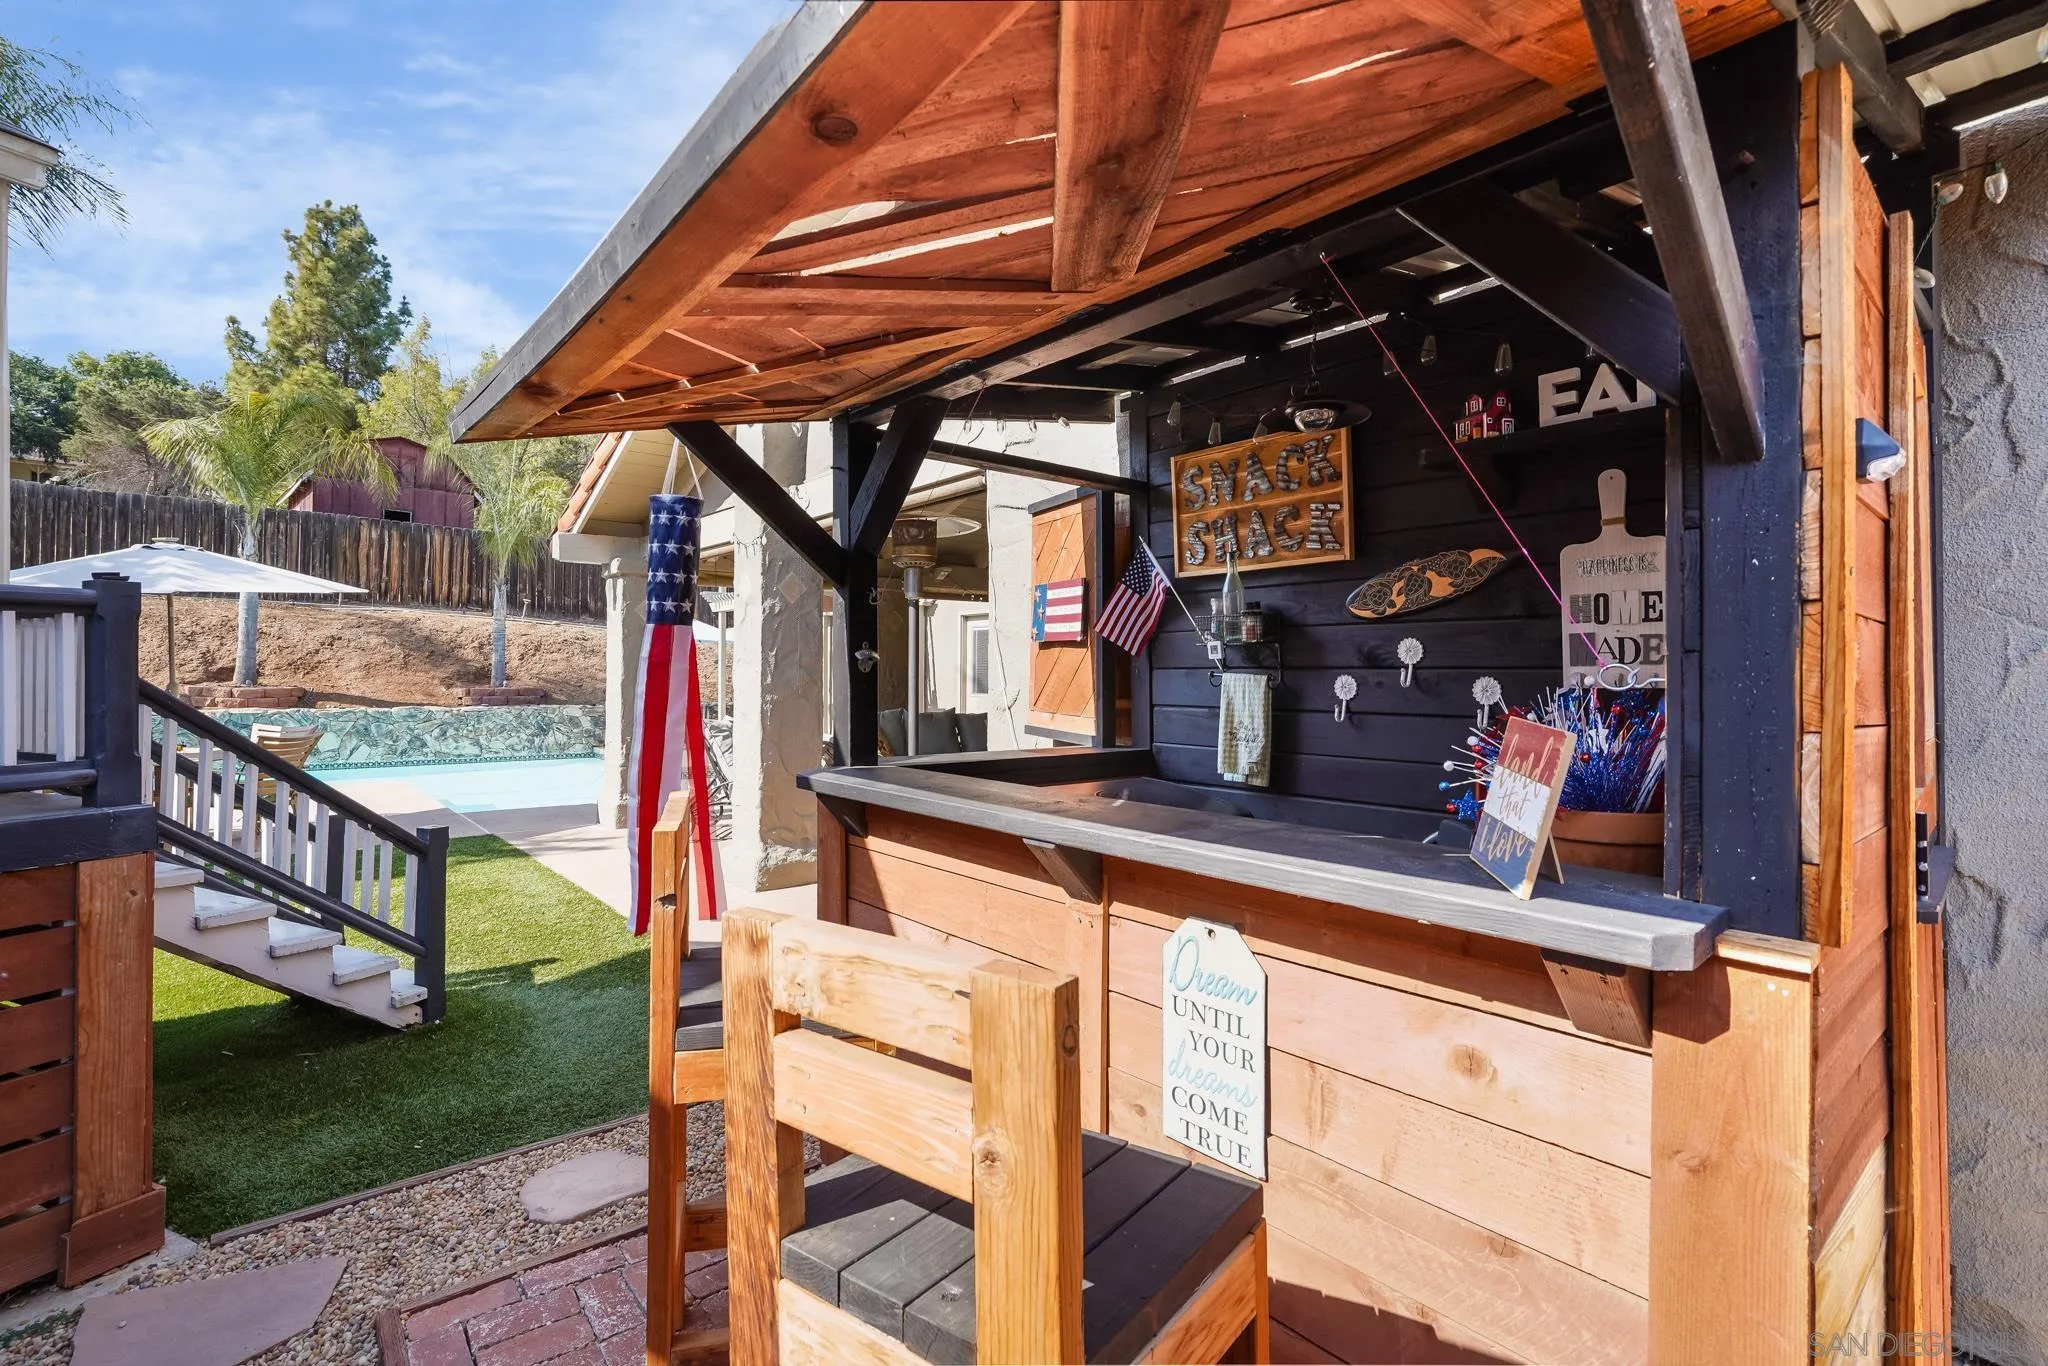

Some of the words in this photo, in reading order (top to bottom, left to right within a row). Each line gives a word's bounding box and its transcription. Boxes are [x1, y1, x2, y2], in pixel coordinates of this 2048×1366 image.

[1182, 434, 1341, 511] SNACK
[1185, 503, 1341, 565] SHACK
[1569, 590, 1663, 625] HOME
[1569, 632, 1664, 667] MADE
[1496, 733, 1553, 797] land
[1497, 788, 1531, 822] that
[1488, 817, 1530, 863] love
[1169, 935, 1258, 1006] Dream
[1172, 994, 1251, 1039] UNTIL
[1168, 1038, 1258, 1108] dreams
[1188, 1029, 1256, 1074] YOUR
[1171, 1086, 1248, 1135] COME
[1180, 1117, 1252, 1169] TRUE
